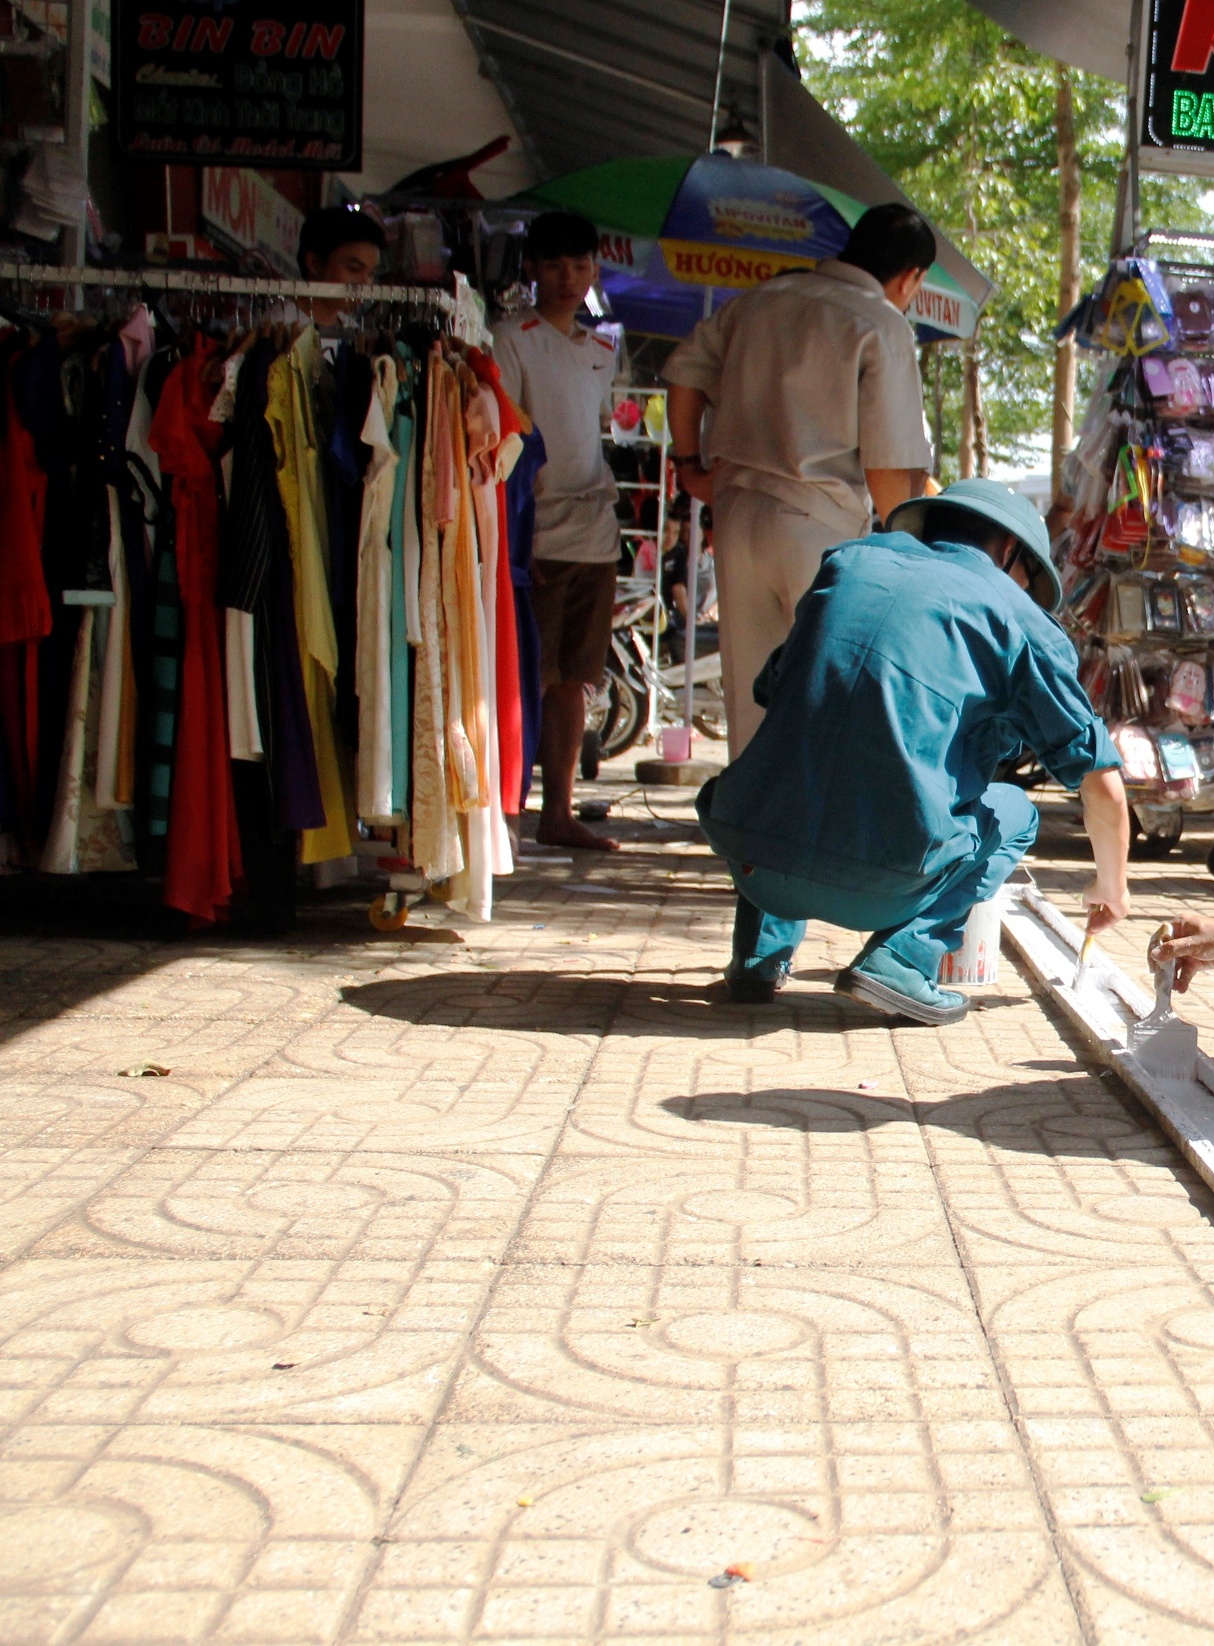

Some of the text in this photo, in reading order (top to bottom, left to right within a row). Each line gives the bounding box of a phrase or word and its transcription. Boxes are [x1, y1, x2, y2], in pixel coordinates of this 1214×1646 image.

[137, 14, 233, 53] BIN
[250, 19, 345, 60] BIN
[674, 251, 774, 283] HƯƠNG
